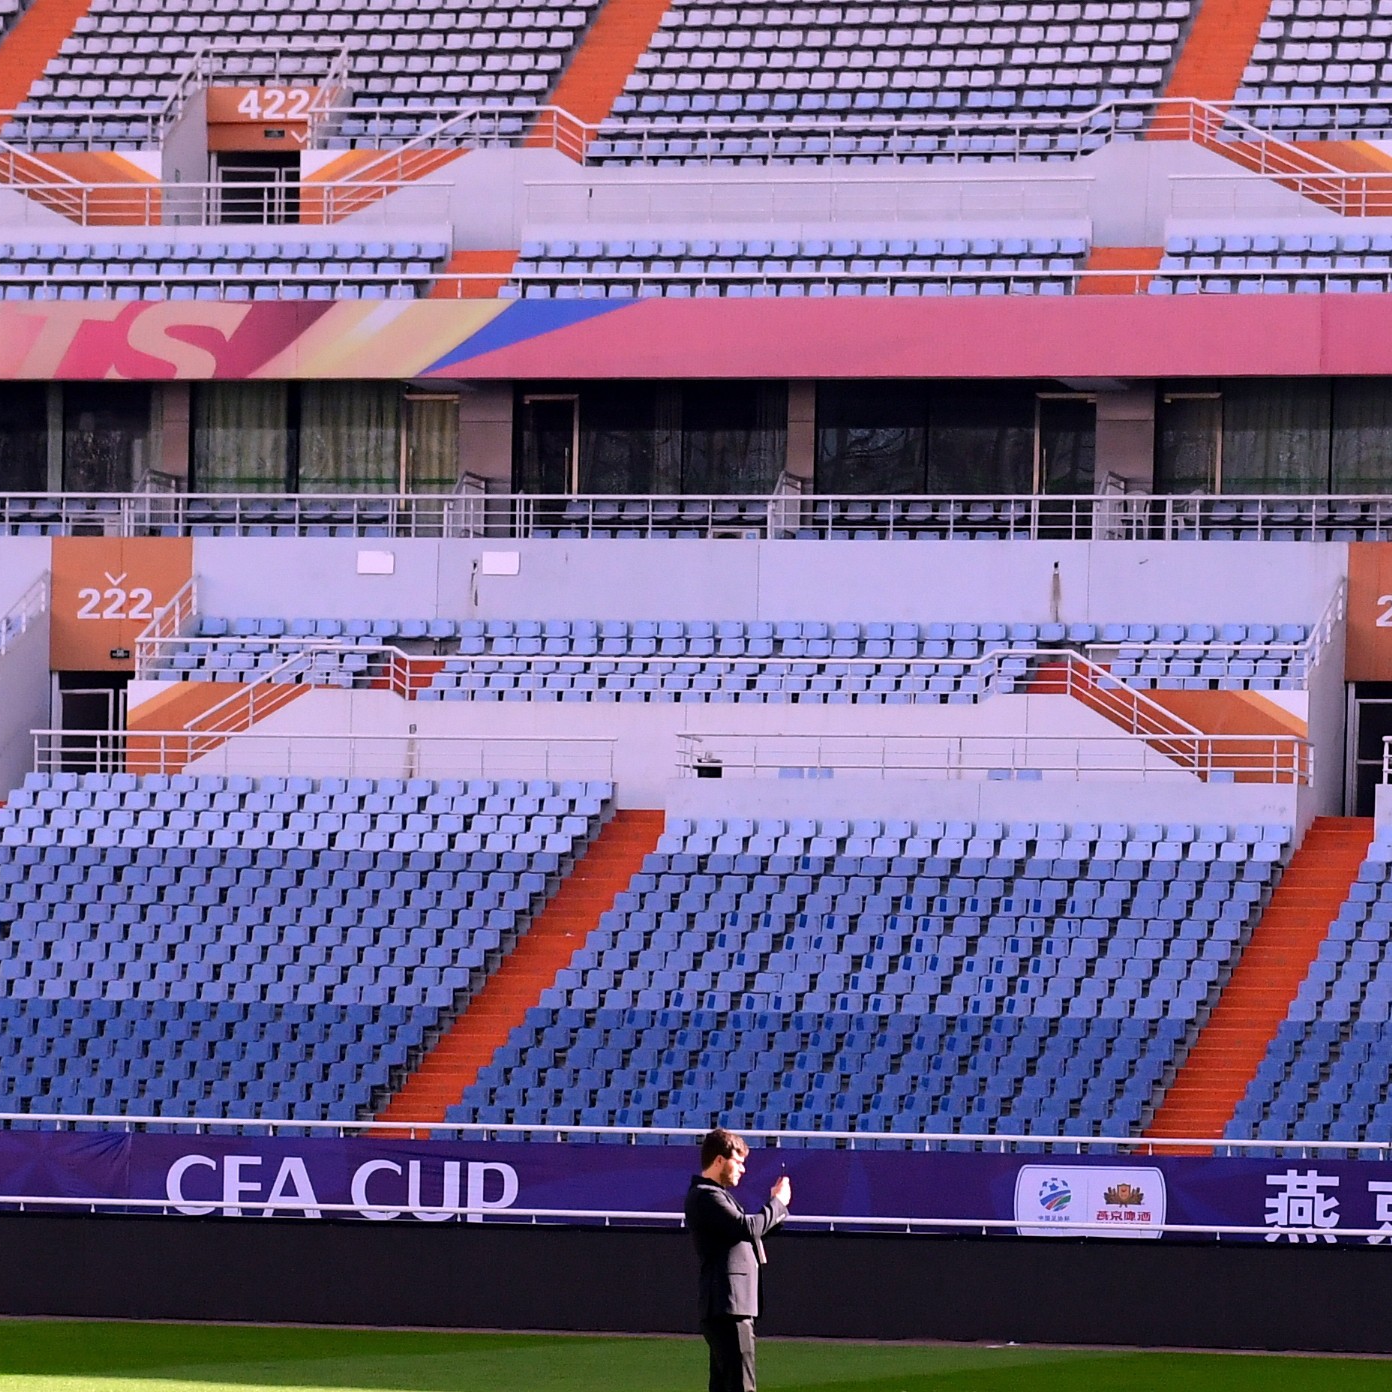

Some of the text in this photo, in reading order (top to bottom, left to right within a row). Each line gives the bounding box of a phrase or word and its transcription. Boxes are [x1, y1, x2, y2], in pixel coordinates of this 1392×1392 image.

[238, 89, 310, 120] 422
[77, 588, 152, 619] 222
[165, 1154, 520, 1223] CFA CUP
